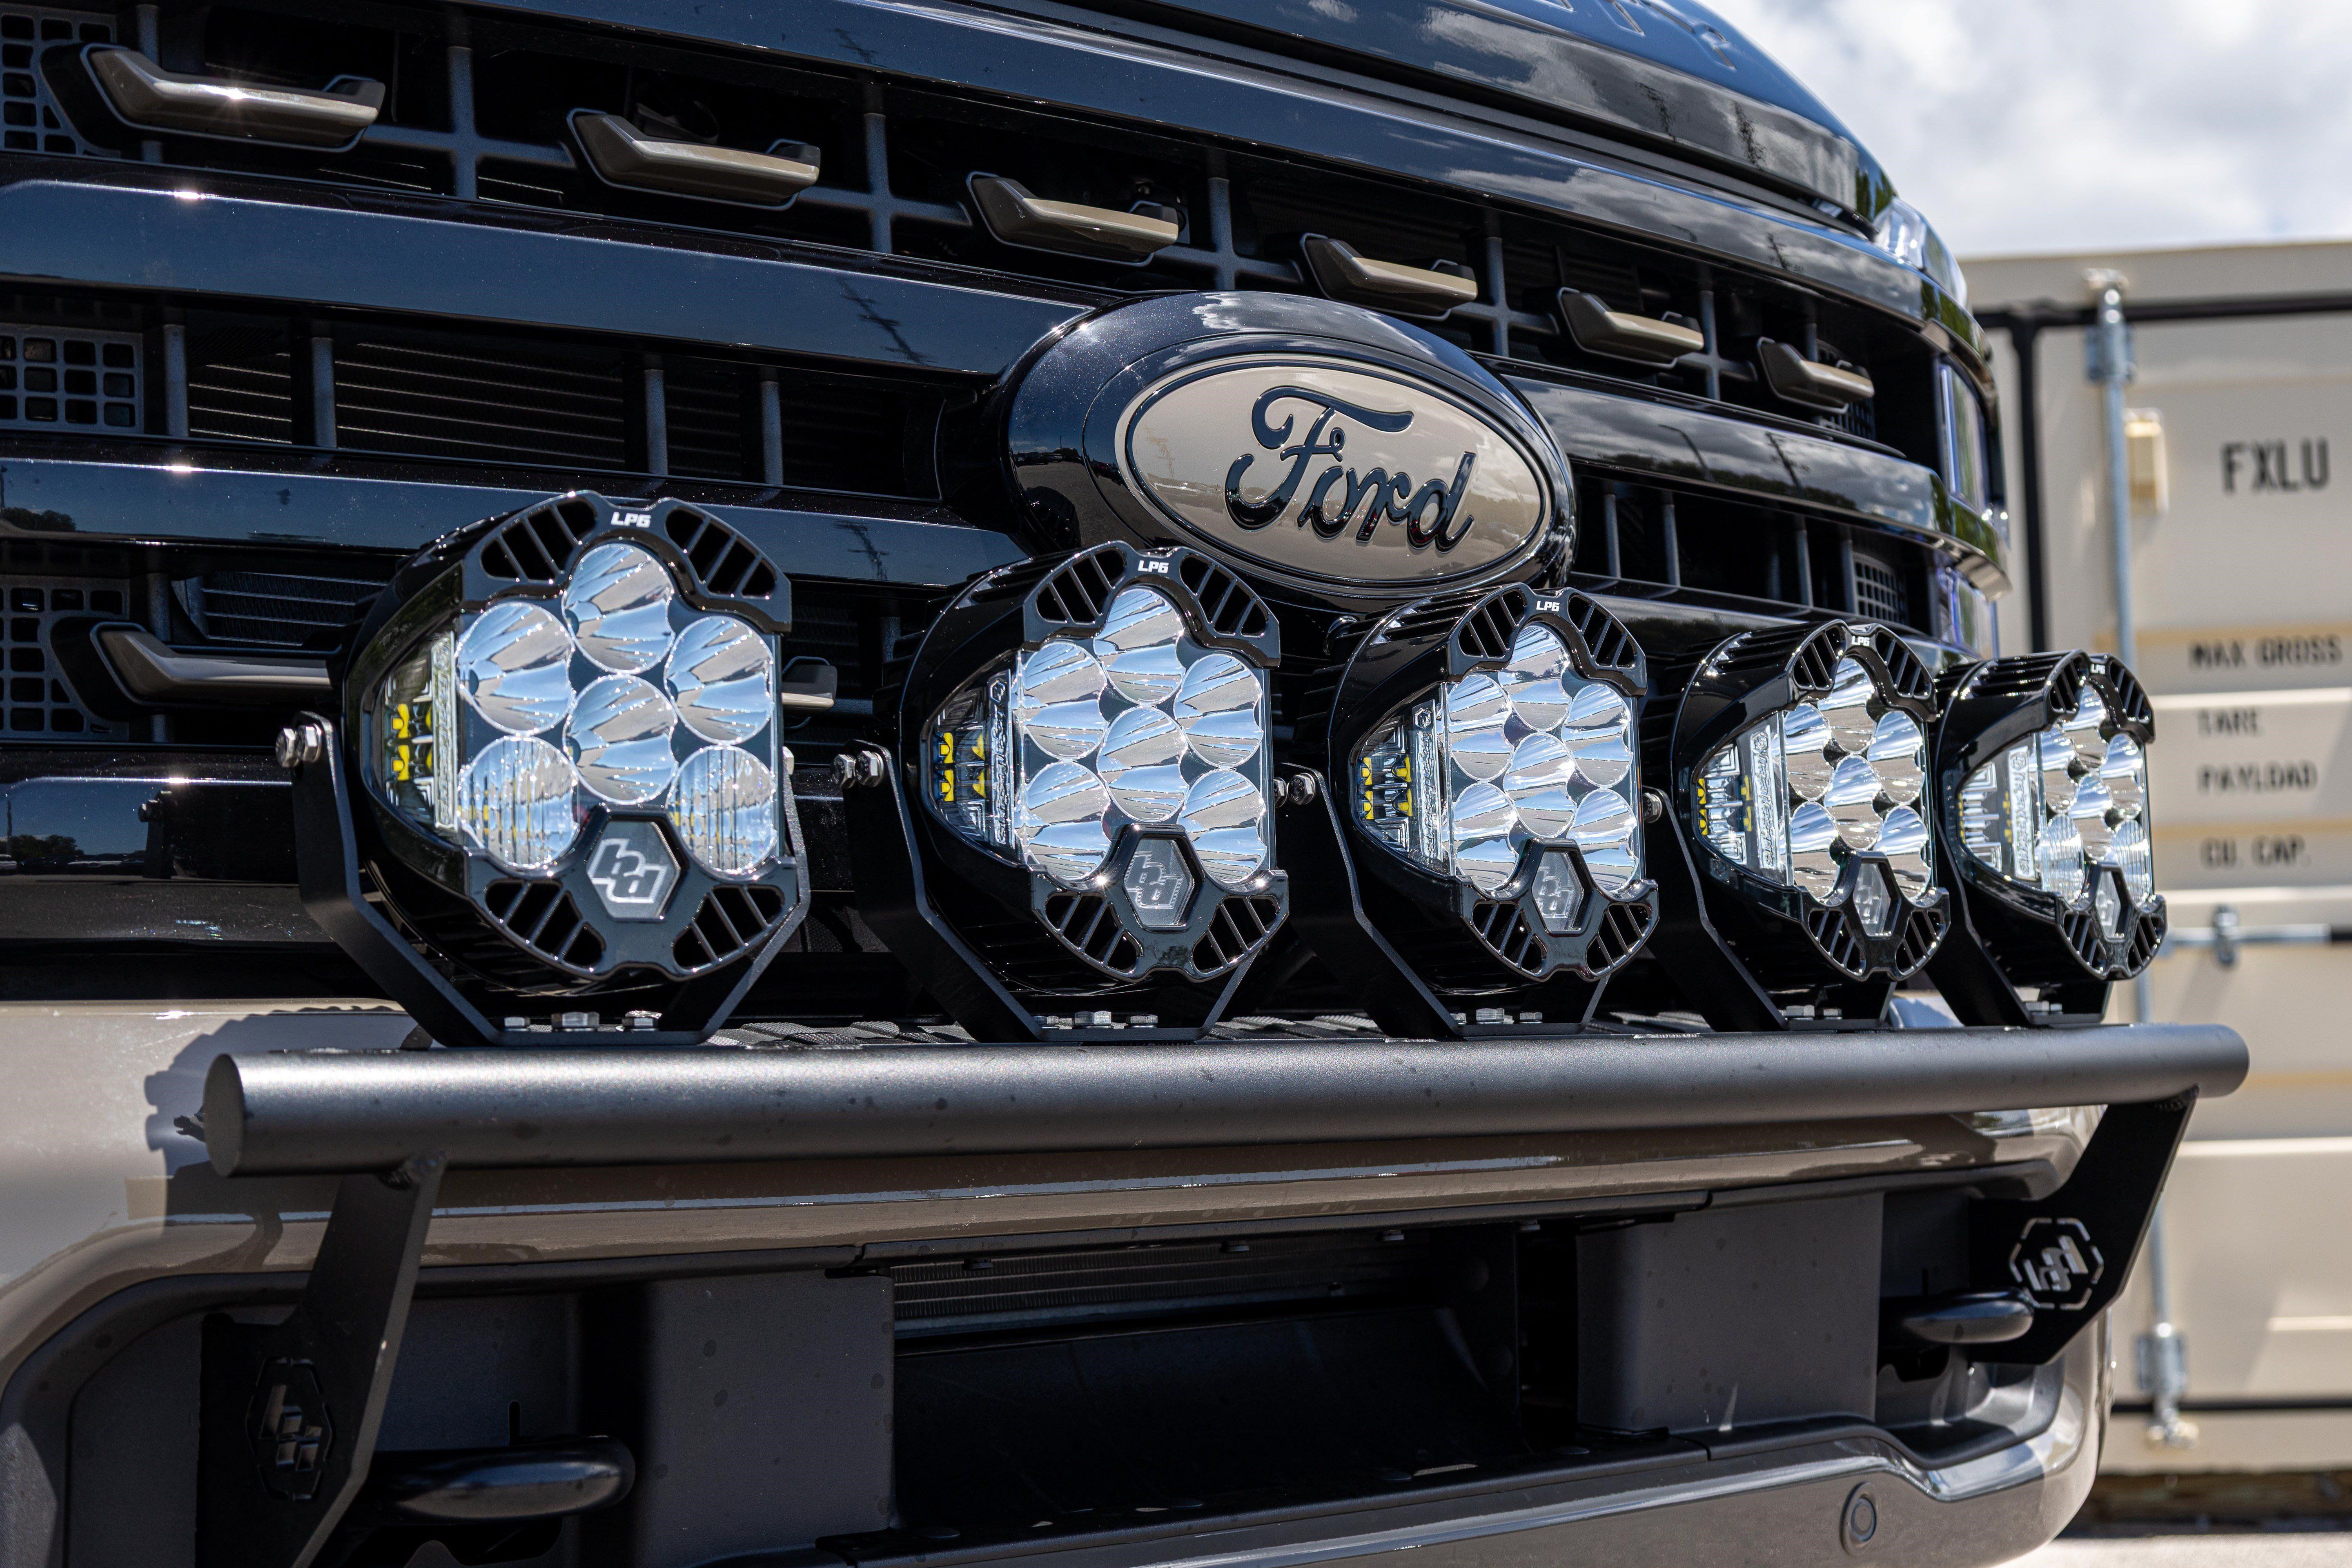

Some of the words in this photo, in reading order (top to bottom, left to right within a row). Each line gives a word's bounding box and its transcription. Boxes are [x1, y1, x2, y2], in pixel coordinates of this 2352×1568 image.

[1225, 385, 1476, 554] Ford
[2221, 436, 2330, 495] FXLU
[611, 512, 652, 528] LP6
[1138, 560, 1169, 573] LP6
[1536, 600, 1560, 612] LP6
[1851, 635, 1870, 646] LP6
[2254, 634, 2342, 667] GROSS
[2090, 664, 2105, 674] LP6
[2197, 761, 2317, 793] PAYLOAD
